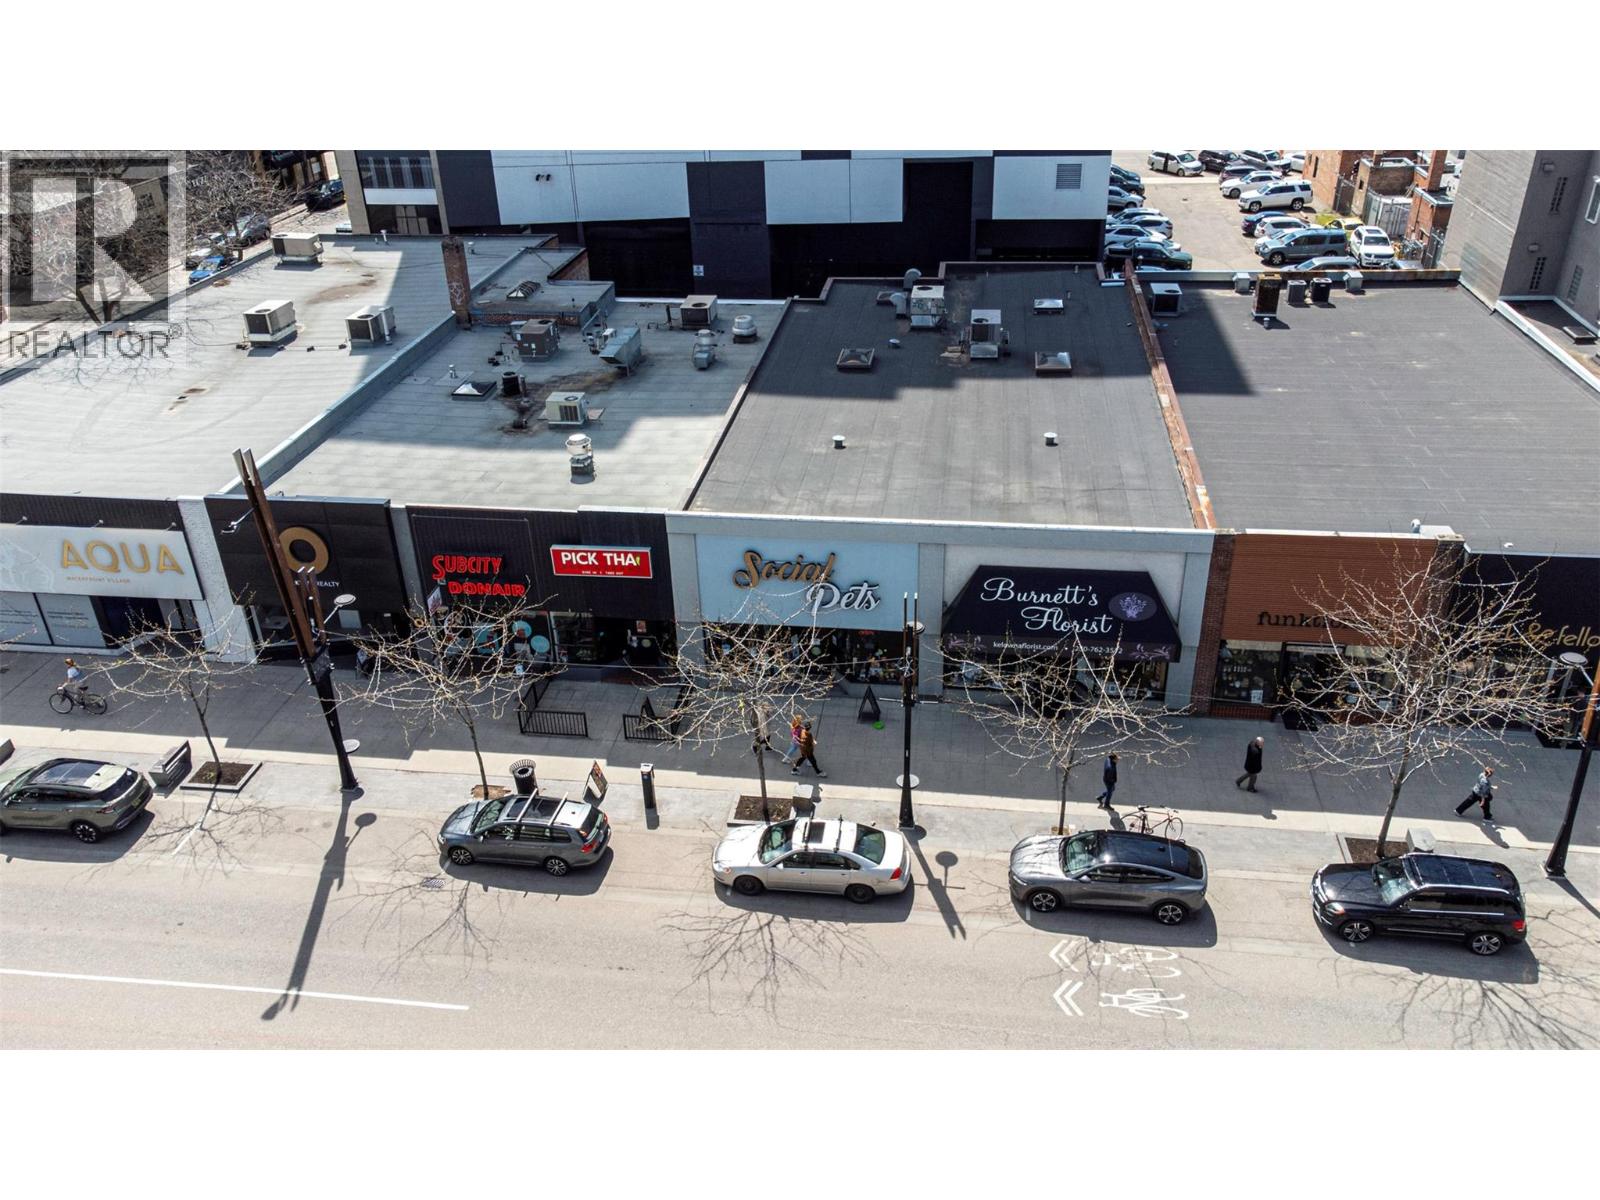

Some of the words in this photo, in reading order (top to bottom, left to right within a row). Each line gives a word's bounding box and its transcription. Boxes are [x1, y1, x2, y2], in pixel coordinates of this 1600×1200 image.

[62, 539, 185, 575] AQUA
[431, 554, 502, 580] SUBCITY
[560, 551, 599, 566] PICK
[732, 550, 835, 589] Social
[447, 581, 526, 597] DONAIR
[806, 580, 881, 616] Pets
[980, 577, 1099, 606] Burnett's
[1021, 606, 1113, 634] Florist
